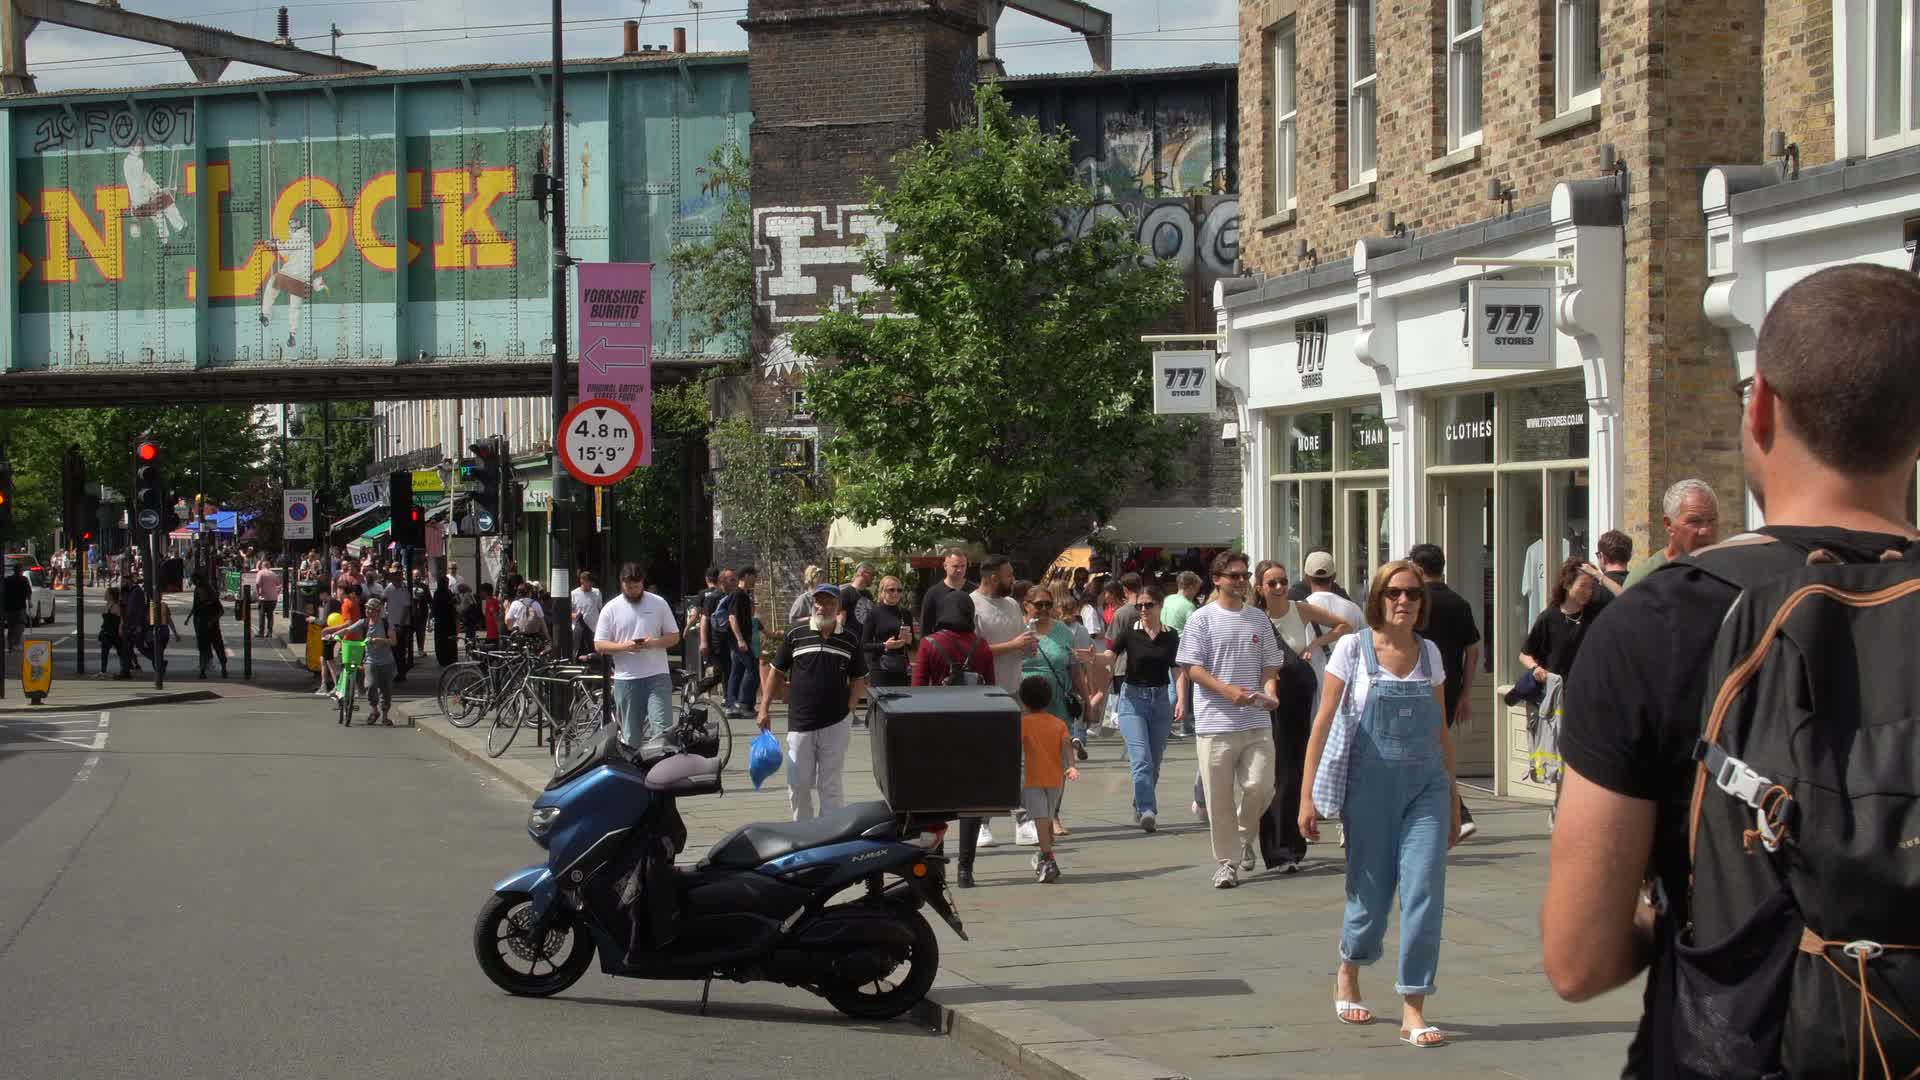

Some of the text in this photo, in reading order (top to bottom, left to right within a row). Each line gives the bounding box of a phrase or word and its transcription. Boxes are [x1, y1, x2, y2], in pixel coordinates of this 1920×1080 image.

[186, 163, 517, 300] LOCK
[584, 288, 646, 304] YORKSHIRE
[590, 304, 640, 319] BURRITO
[1485, 304, 1543, 334] 777
[1495, 337, 1534, 345] STORES
[1164, 368, 1206, 389] 777
[1301, 372, 1323, 389] STORES
[575, 420, 628, 438] 4.8 m
[1298, 420, 1492, 451] MORE THAN CLOTHES
